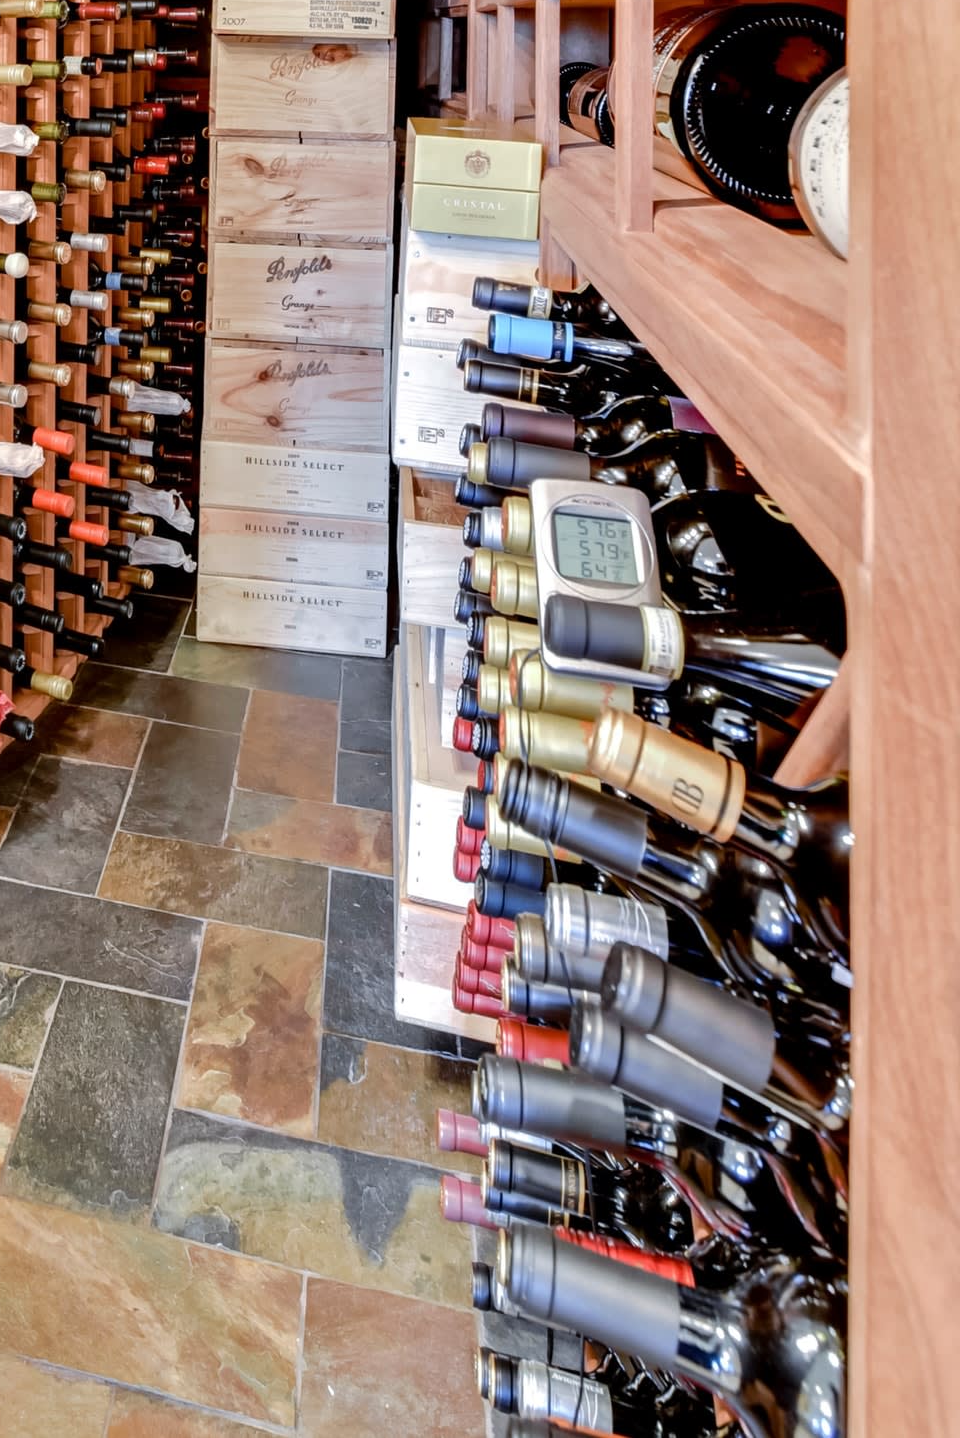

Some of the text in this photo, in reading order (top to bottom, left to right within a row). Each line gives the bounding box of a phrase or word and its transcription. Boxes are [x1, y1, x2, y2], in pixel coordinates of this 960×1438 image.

[442, 197, 505, 211] CRISTAL
[266, 254, 333, 283] Penfolds
[281, 294, 315, 312] Grange
[245, 456, 297, 468] HILLSIDE
[303, 459, 344, 472] SELECT
[244, 523, 297, 535] HILLSIDE
[302, 528, 344, 539] SELECT
[242, 590, 294, 603] HILLSIDE
[300, 596, 343, 608] SELECT
